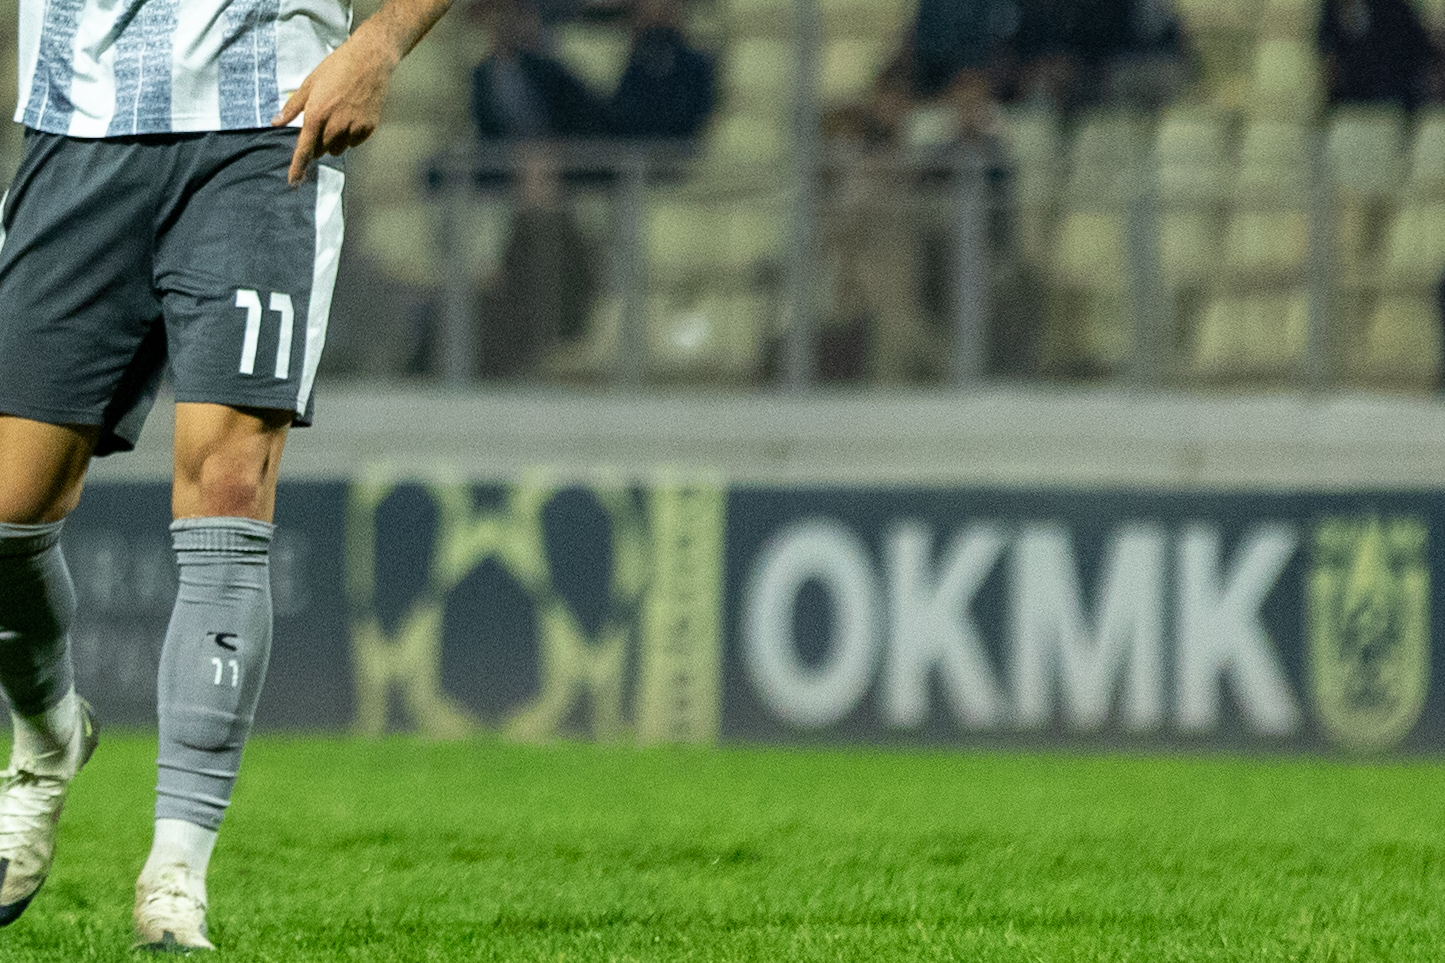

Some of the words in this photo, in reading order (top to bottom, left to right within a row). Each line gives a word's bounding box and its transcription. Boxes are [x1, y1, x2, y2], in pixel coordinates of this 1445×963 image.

[235, 289, 294, 379] 11
[744, 516, 1302, 733] OKMK
[211, 657, 239, 688] 11
